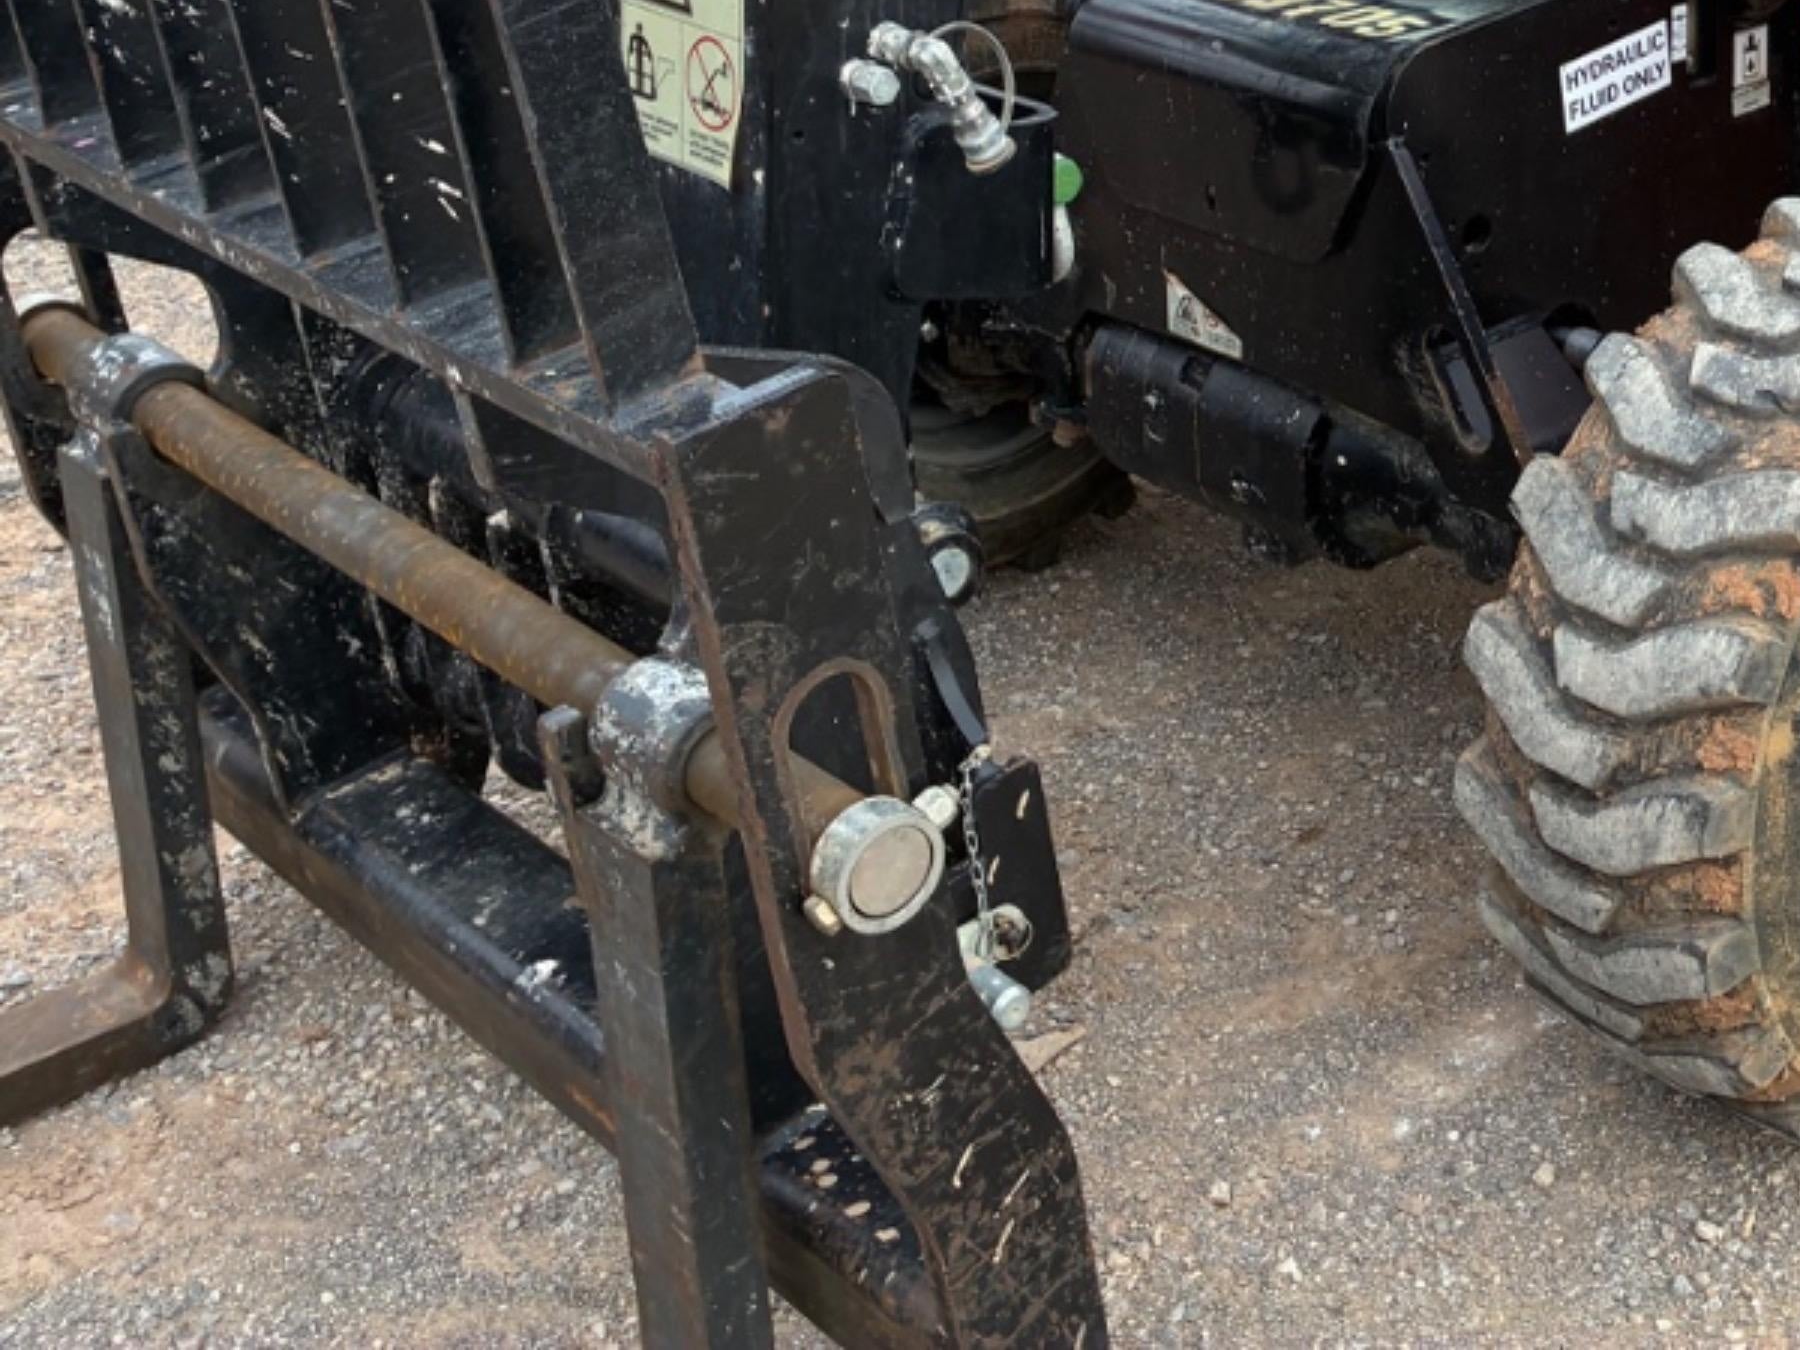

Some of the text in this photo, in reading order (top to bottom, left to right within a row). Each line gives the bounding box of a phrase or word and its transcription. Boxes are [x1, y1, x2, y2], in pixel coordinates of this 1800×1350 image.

[1565, 28, 1666, 92] HYDRAULIC
[1568, 58, 1667, 122] FLUID ONLY
